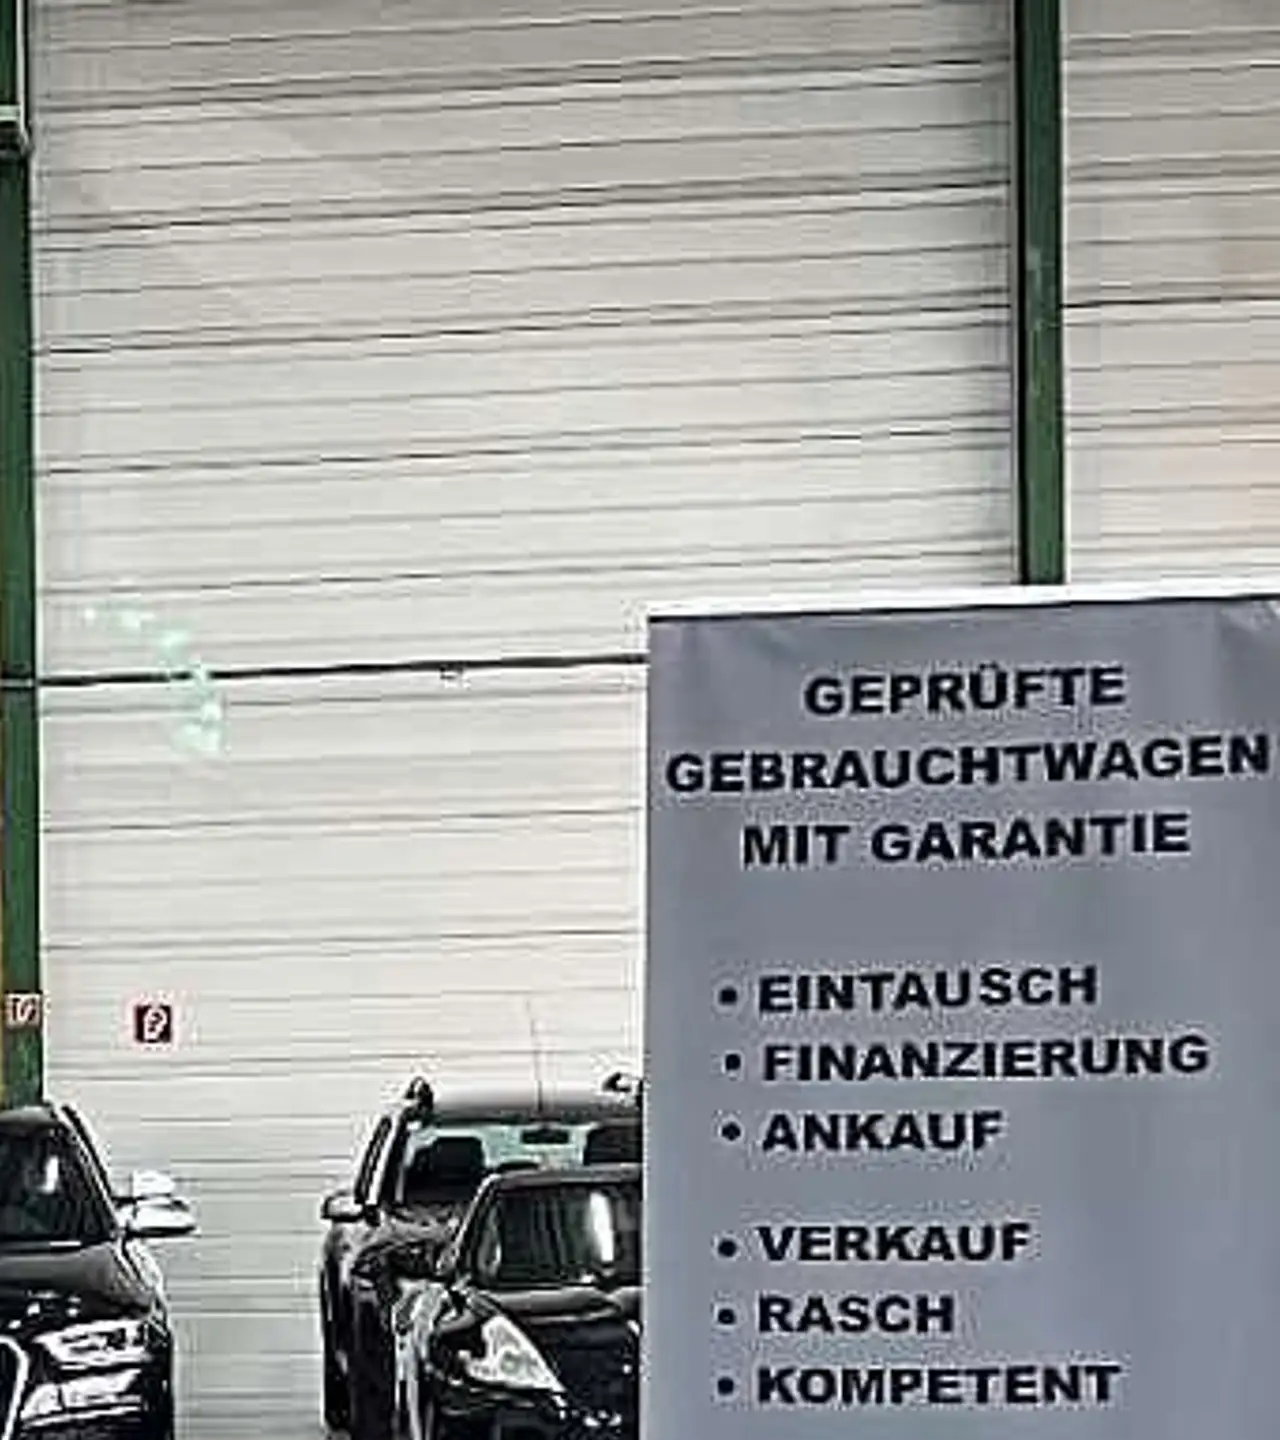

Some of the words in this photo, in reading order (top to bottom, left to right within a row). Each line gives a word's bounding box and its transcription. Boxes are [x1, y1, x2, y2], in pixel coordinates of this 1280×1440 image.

[804, 663, 1126, 716] GEPRÜFTE
[666, 733, 1269, 793] GEBRAUCHTWAGEN
[744, 825, 851, 867] MIT
[871, 813, 1191, 863] GARANTIE
[759, 965, 1097, 1013] EINTAUSCH
[764, 1035, 1209, 1081] FINANZIERUNG
[762, 1110, 1003, 1152] ANKAUF
[757, 1222, 1031, 1262] VERKAUF
[759, 1295, 955, 1333] RASCH
[758, 1365, 1122, 1405] KOMPETENT
